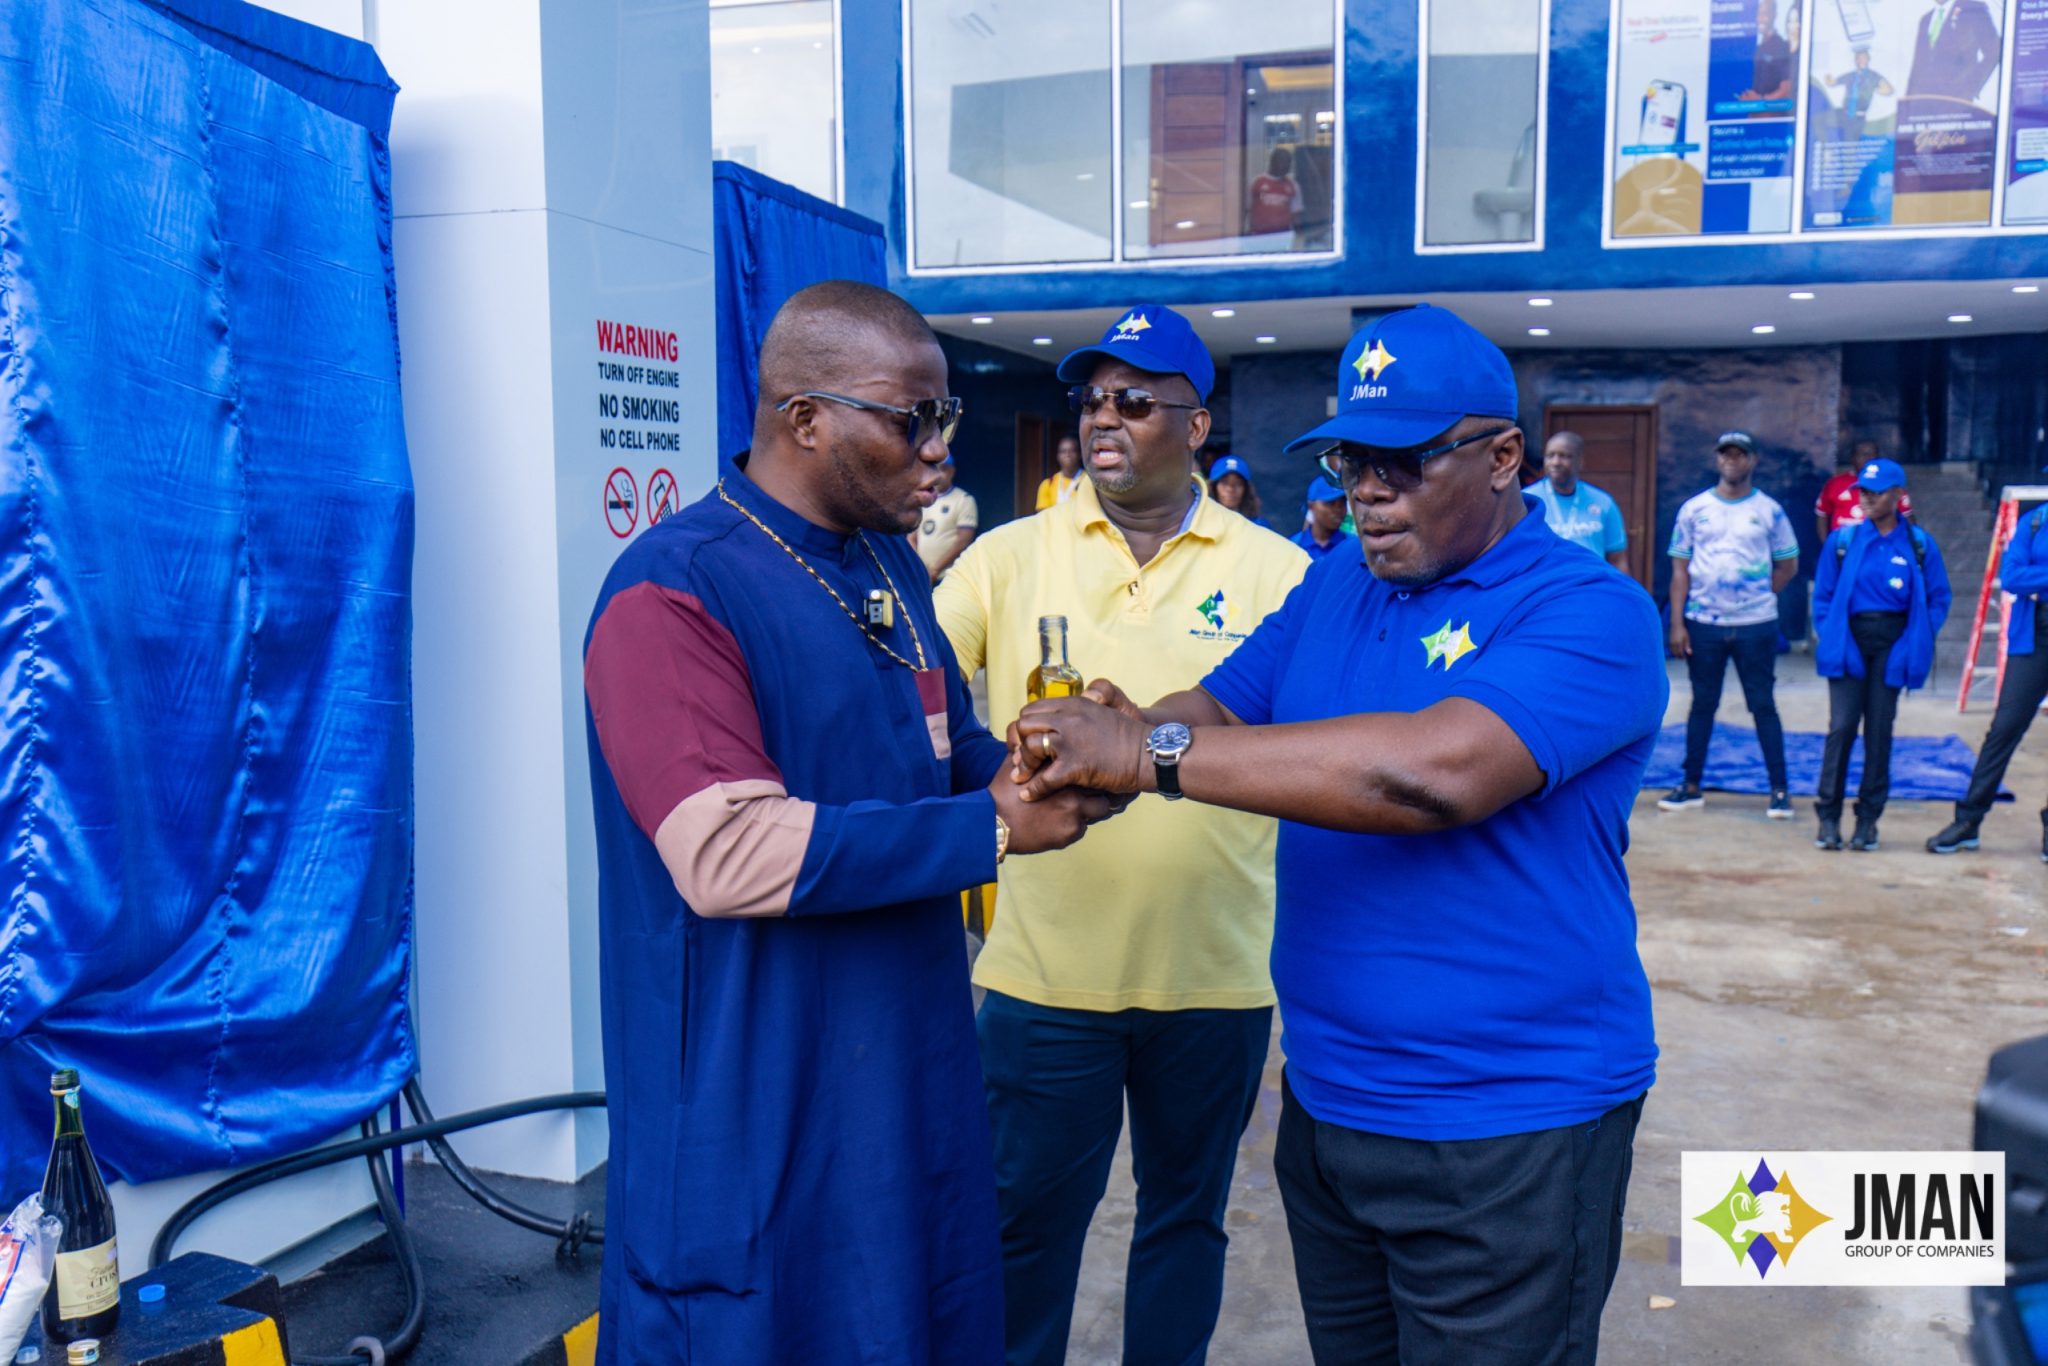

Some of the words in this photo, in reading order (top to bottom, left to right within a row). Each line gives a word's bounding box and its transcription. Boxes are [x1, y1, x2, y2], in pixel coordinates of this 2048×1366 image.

[596, 320, 679, 362] WARNING
[1108, 333, 1140, 344] JMan
[598, 362, 625, 382] TURN
[627, 365, 644, 384] OFF
[647, 368, 680, 388] ENGINE
[1350, 384, 1388, 401] JMan
[599, 393, 618, 418] NO
[622, 396, 680, 424] SMOKING
[600, 428, 617, 448] NO
[619, 429, 645, 450] CELL
[647, 431, 681, 451] PHONE
